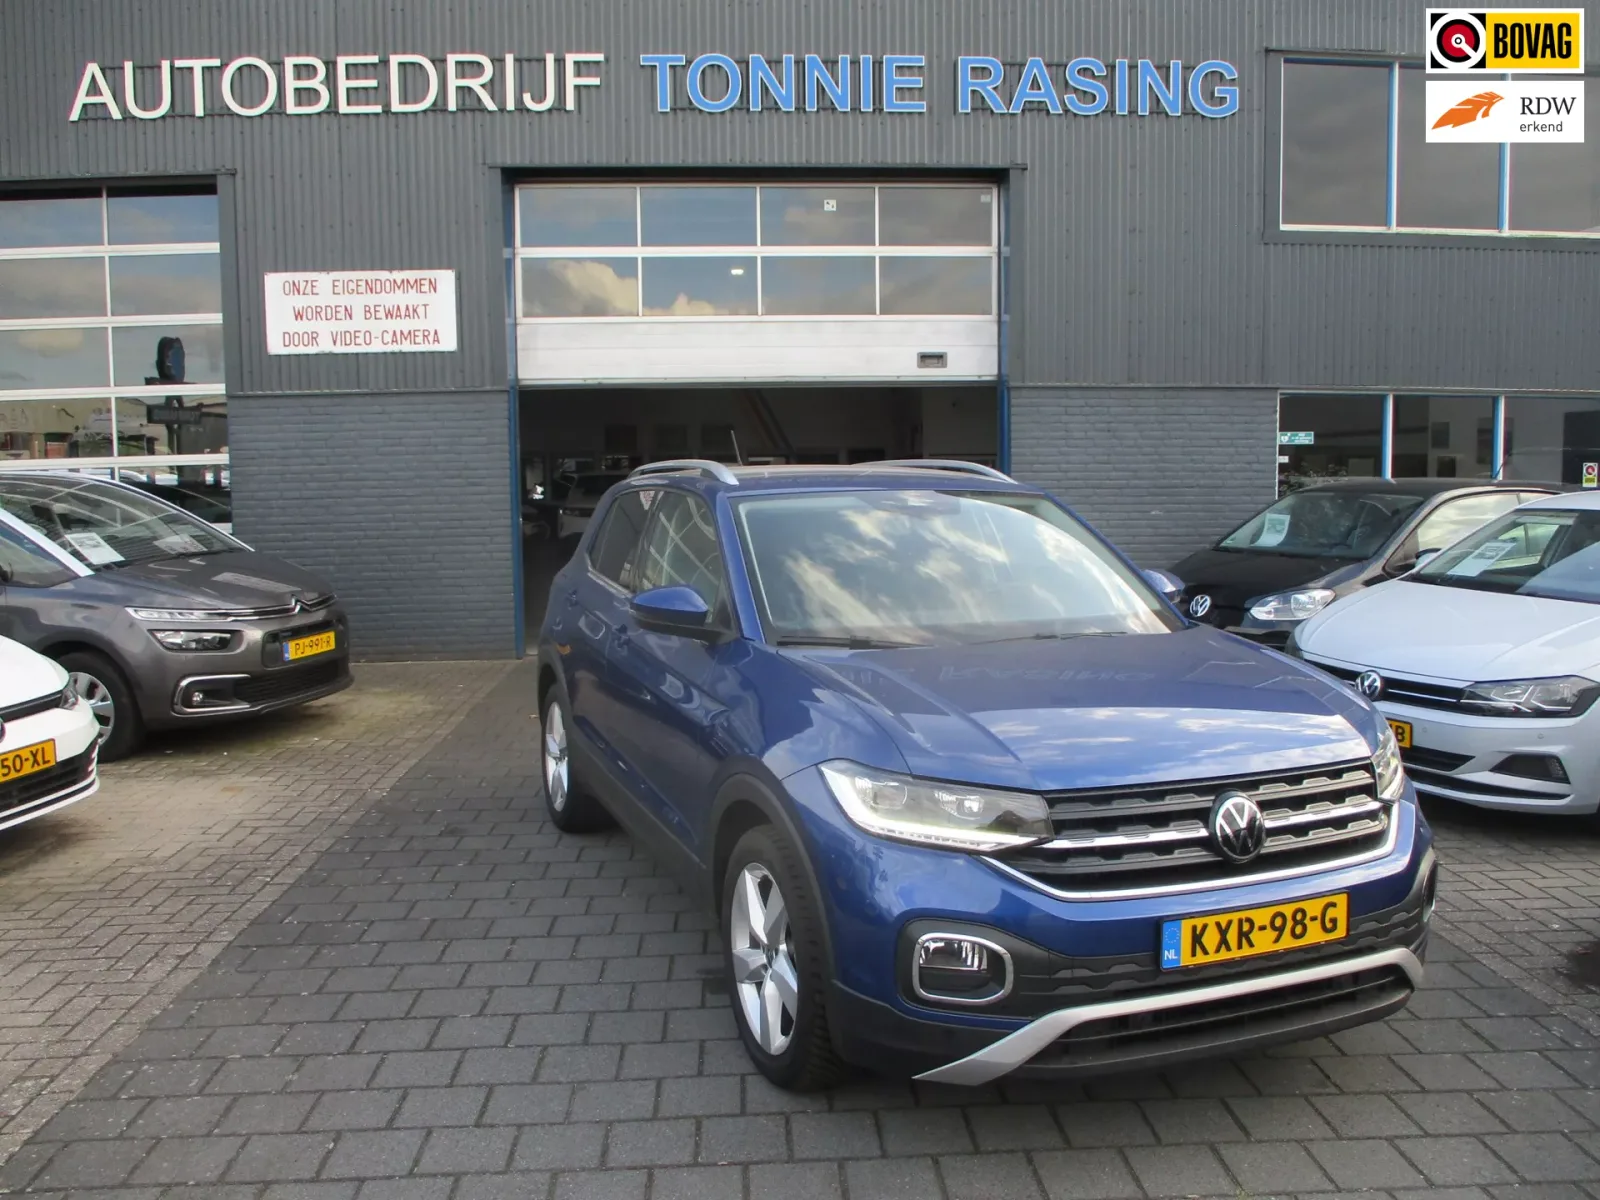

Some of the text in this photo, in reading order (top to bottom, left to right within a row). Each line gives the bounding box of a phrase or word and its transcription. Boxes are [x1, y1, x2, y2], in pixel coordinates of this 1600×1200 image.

[69, 53, 1239, 122] AUTOBEDRIJF TONNIE RASING
[282, 277, 438, 296] ONZE EIGENDOMMEN
[292, 303, 430, 322] WORDEN BEWAAKT
[282, 329, 441, 347] DOOR VIDEO-CAMERA
[1164, 901, 1338, 961] NL KXR-98-G
